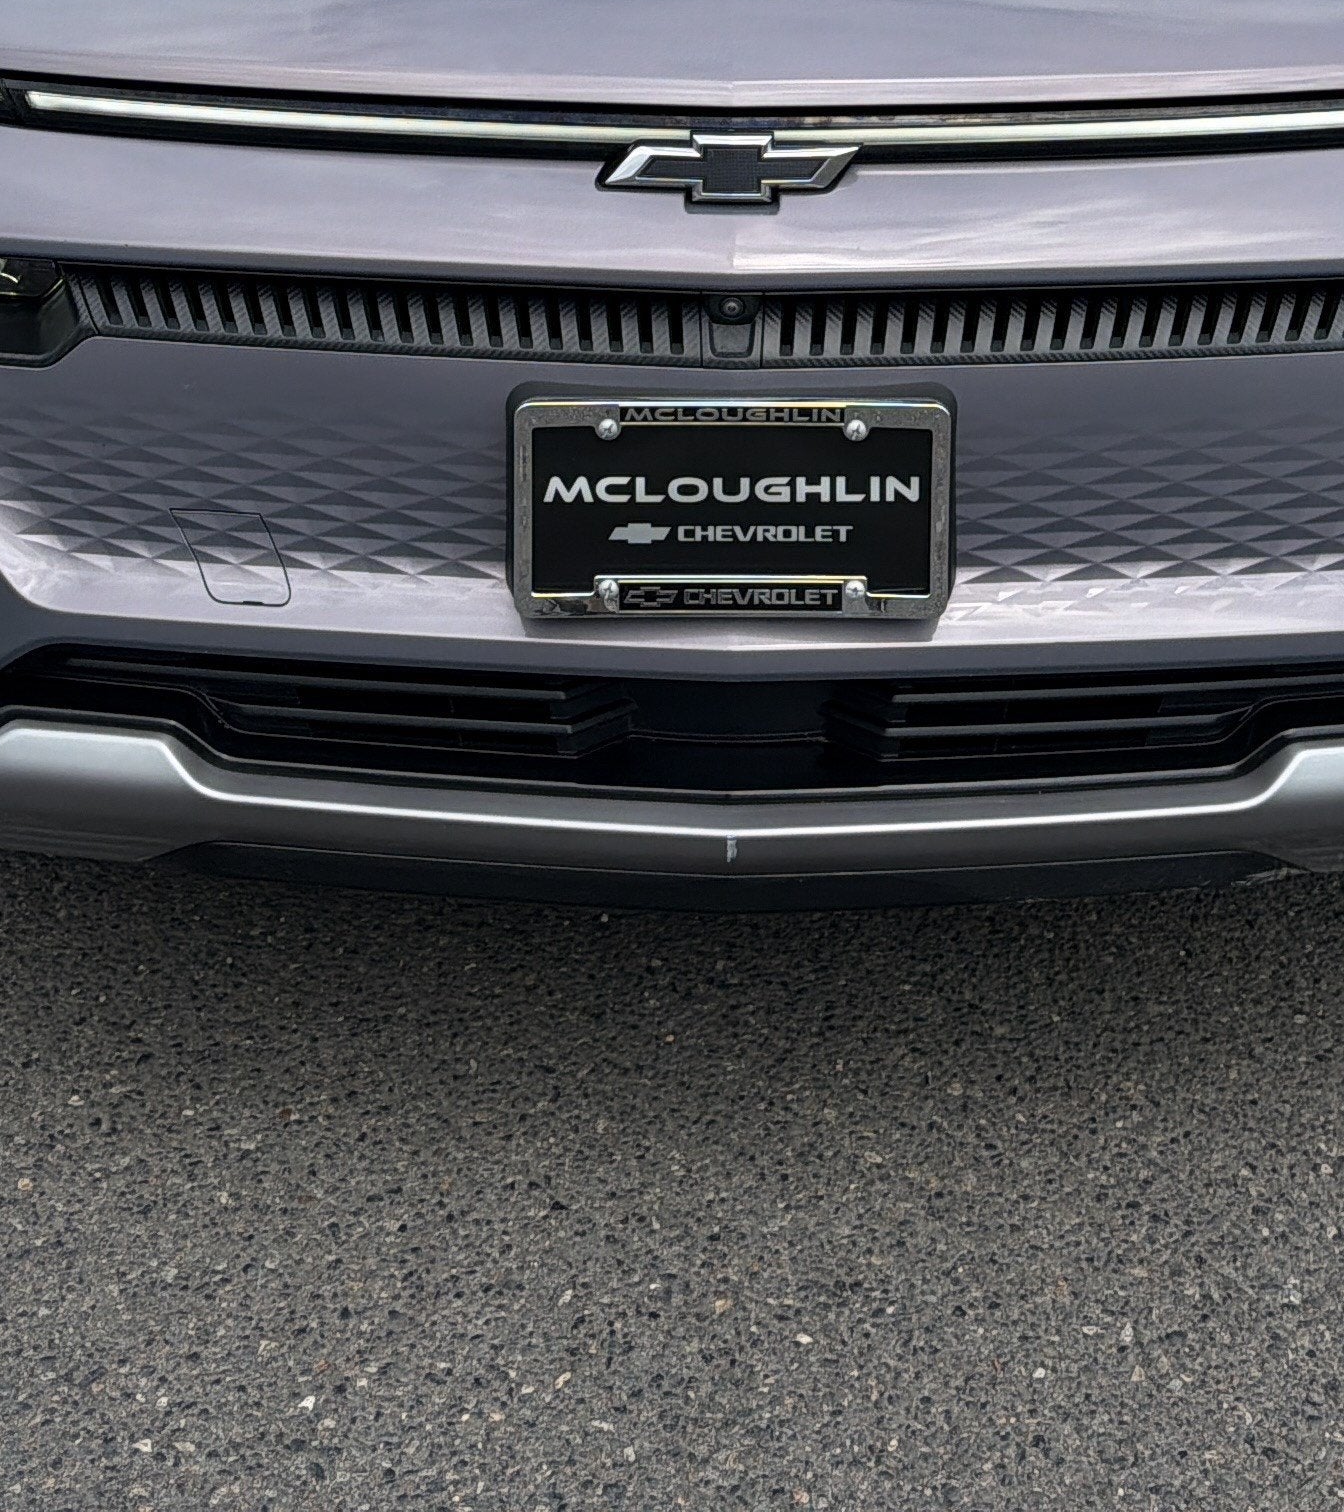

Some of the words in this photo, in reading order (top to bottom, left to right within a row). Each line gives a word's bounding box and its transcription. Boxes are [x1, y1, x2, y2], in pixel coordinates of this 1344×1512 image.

[624, 407, 842, 423] MCLOUGHLIN
[542, 475, 921, 504] MCLOUGHLIN
[677, 525, 854, 543] CHEVROLET
[683, 589, 839, 606] CHEVROLET
